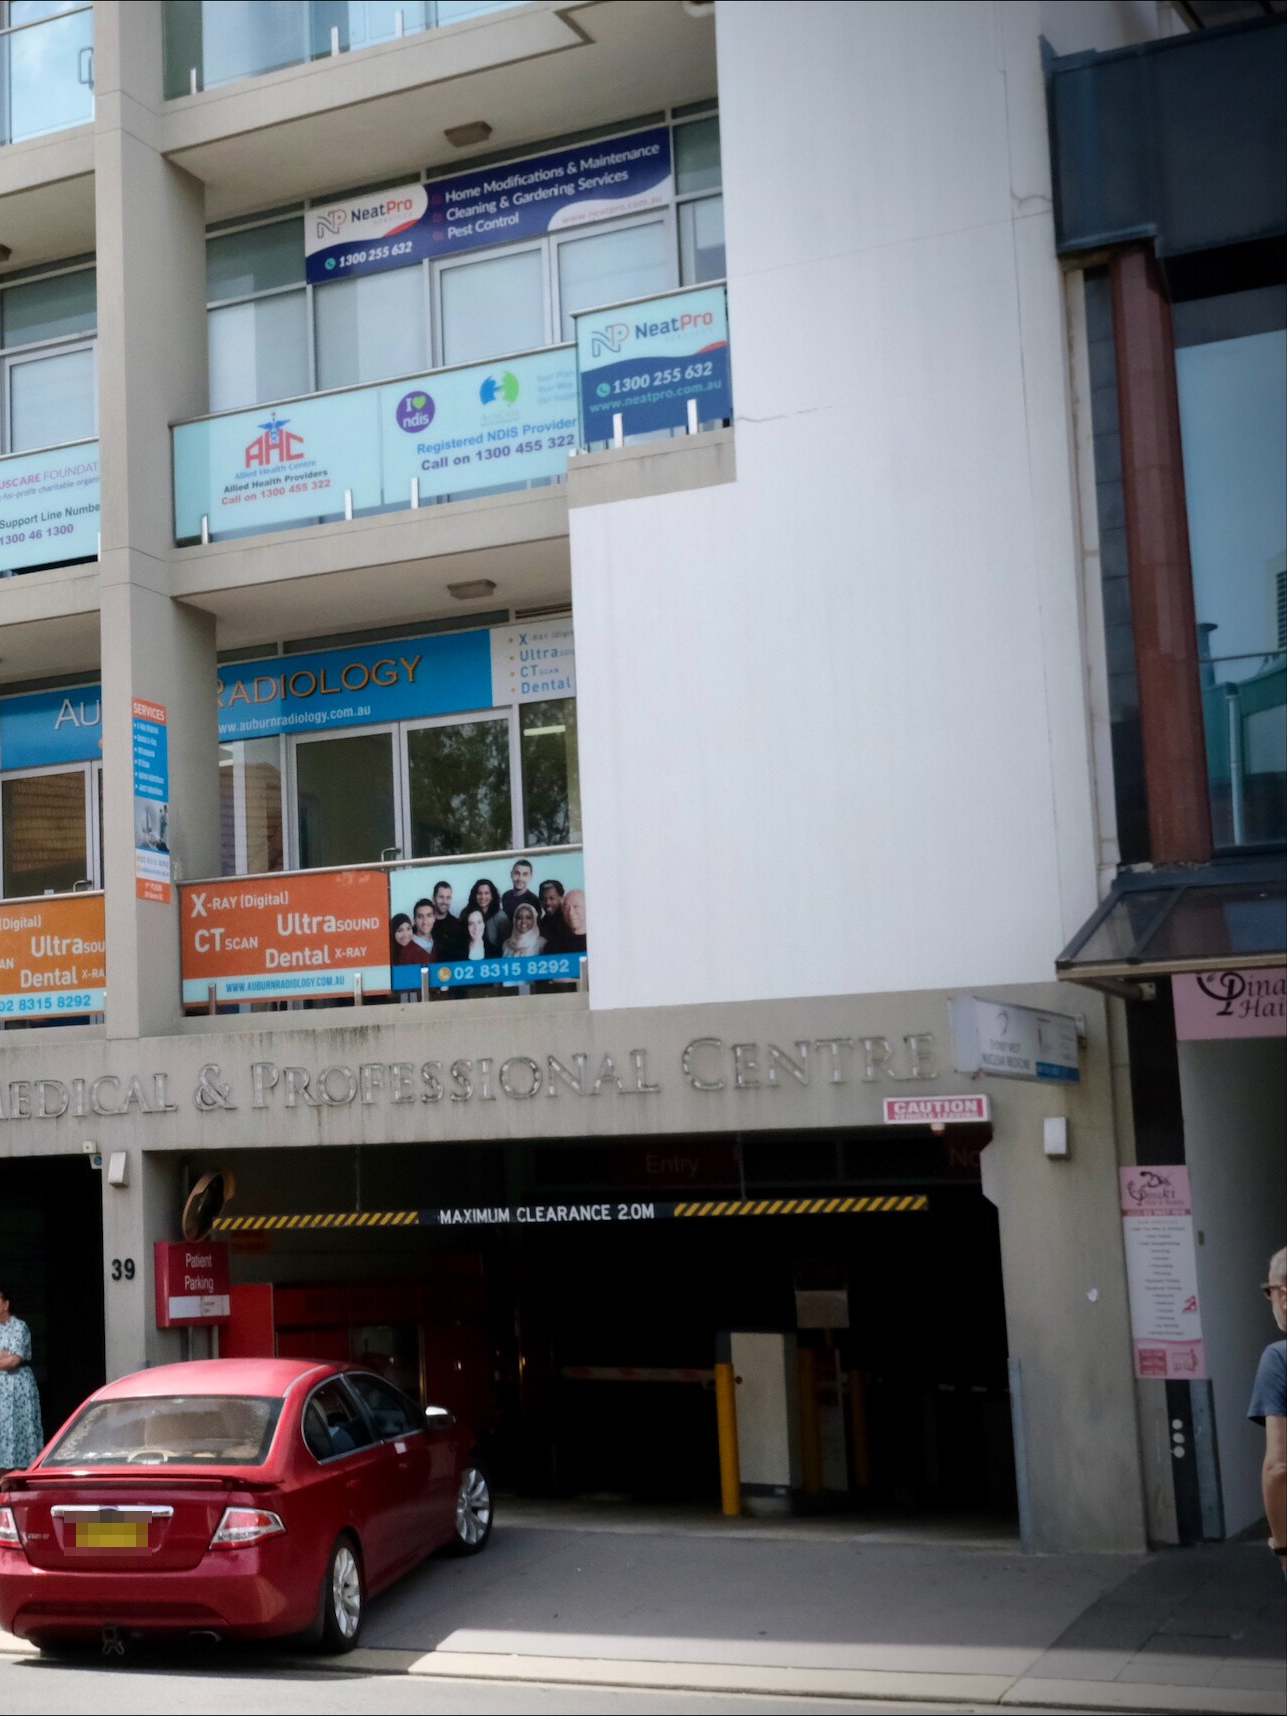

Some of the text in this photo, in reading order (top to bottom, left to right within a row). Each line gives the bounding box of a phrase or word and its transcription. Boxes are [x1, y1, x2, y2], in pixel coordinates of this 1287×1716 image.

[445, 143, 660, 204] Home Modifications & Maintenance
[446, 169, 629, 222] Cleaning & Gardening Services
[351, 197, 413, 224] NeatPro
[447, 212, 520, 240] Pest Control
[339, 241, 413, 268] 1300 255 632
[635, 312, 713, 339] NeatPro
[613, 361, 713, 394] 1300 255 632
[590, 379, 722, 413] www.neatpro.com.au
[402, 412, 430, 429] ndis
[245, 428, 304, 468] AHC
[417, 433, 483, 455] Registered
[487, 427, 518, 442] NDIS
[522, 417, 577, 436] Provider
[421, 434, 575, 471] Call on 1300 455 322
[234, 459, 317, 480] Allied Health Centre
[38, 480, 75, 495] charitable
[221, 479, 331, 506] Call on 1300 455 322
[223, 470, 329, 494] Allied Health Providers
[0, 514, 39, 531] Support
[41, 509, 62, 522] Line
[0, 523, 74, 546] 1300 46 1300
[521, 676, 571, 695] Dental
[133, 701, 166, 722] SERVICES
[191, 890, 289, 918] X-RAY (Digital)
[265, 944, 367, 969] Dental X-RAY
[20, 965, 78, 989] Dental
[453, 958, 569, 981] 02 8315 8292
[225, 975, 346, 994] WWW.AUBURNRADIOLOGY.COM.AU
[18, 997, 52, 1011] 8315
[57, 994, 91, 1009] 8292
[194, 1062, 237, 1112] &
[251, 1047, 662, 1110] PROFESSIONAL
[681, 1032, 940, 1092] CENTRE
[893, 1100, 977, 1114] CAUTION
[645, 1154, 700, 1179] Entry
[439, 1208, 511, 1225] MAXIMUM
[516, 1205, 612, 1222] CLEARANCE
[111, 1258, 136, 1281] 39
[185, 1252, 213, 1268] Patient
[184, 1275, 214, 1294] Parking
